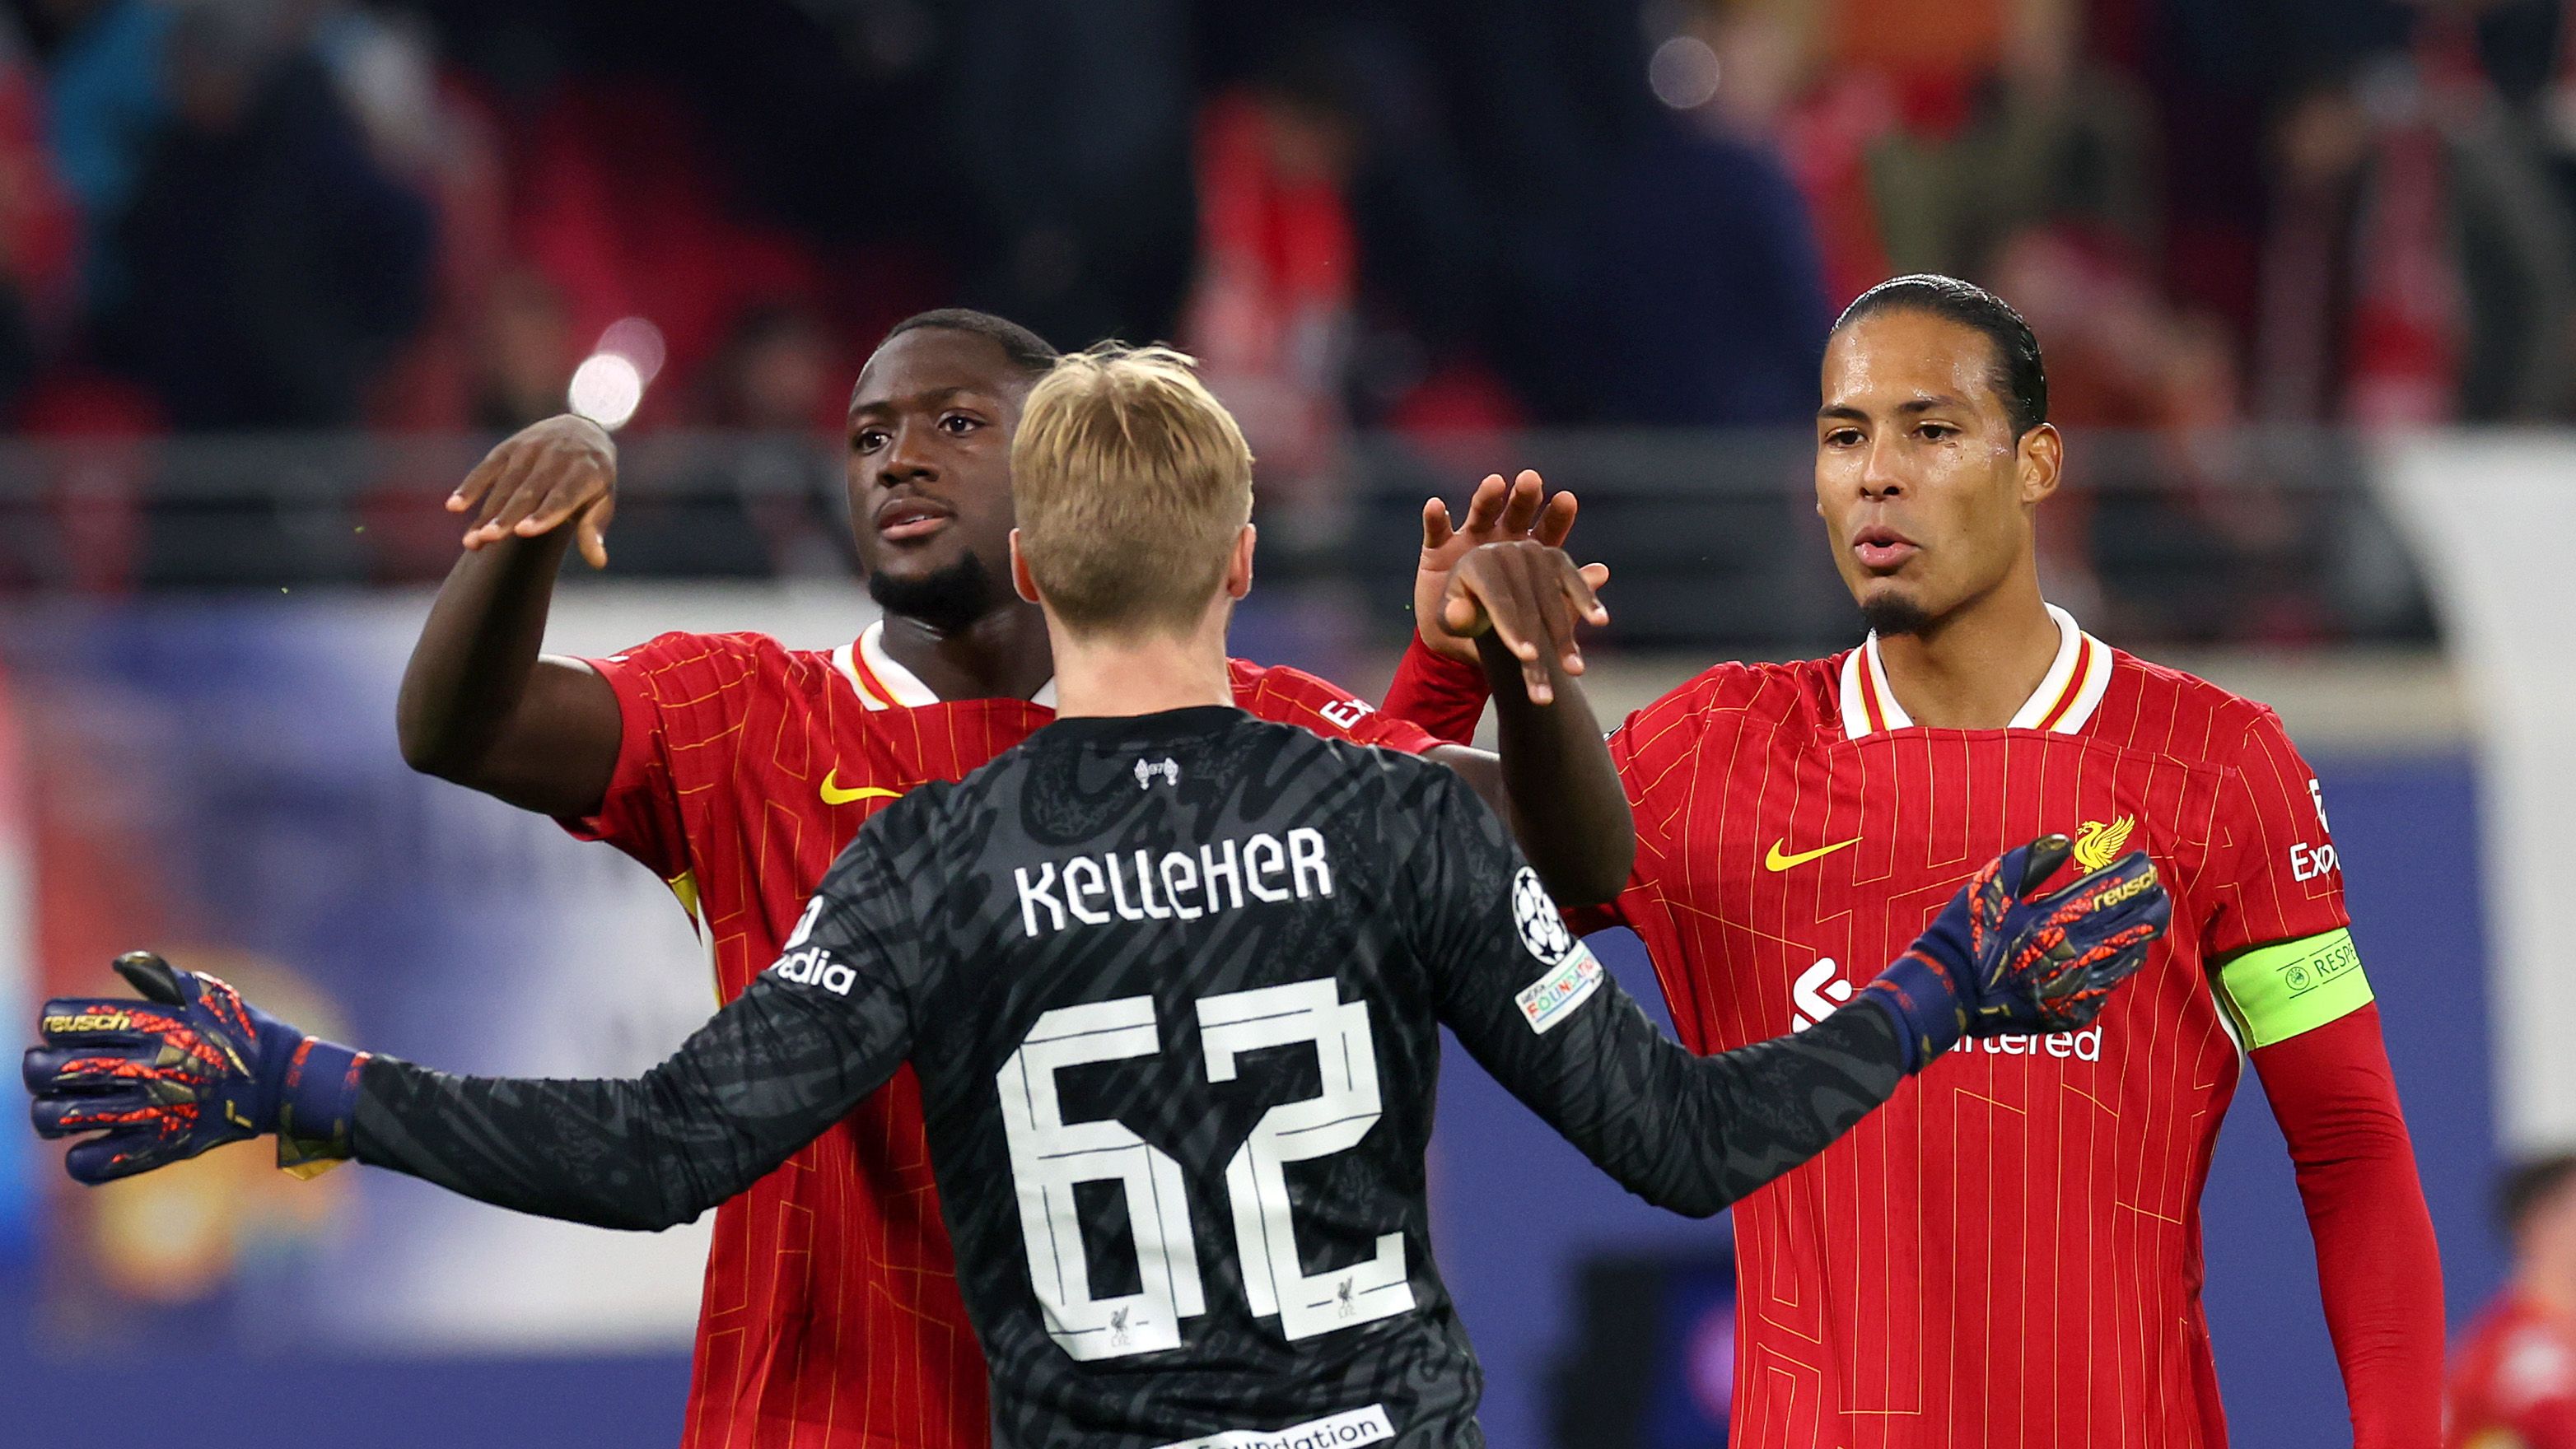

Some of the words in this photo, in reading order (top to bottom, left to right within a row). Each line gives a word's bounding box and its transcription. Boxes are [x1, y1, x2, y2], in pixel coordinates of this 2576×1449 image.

[1319, 698, 1375, 729] Ex
[2290, 842, 2340, 882] Exp
[2093, 863, 2158, 912] reusch
[769, 947, 857, 995] edia
[42, 1011, 131, 1033] reusch
[996, 976, 1416, 1362] 62
